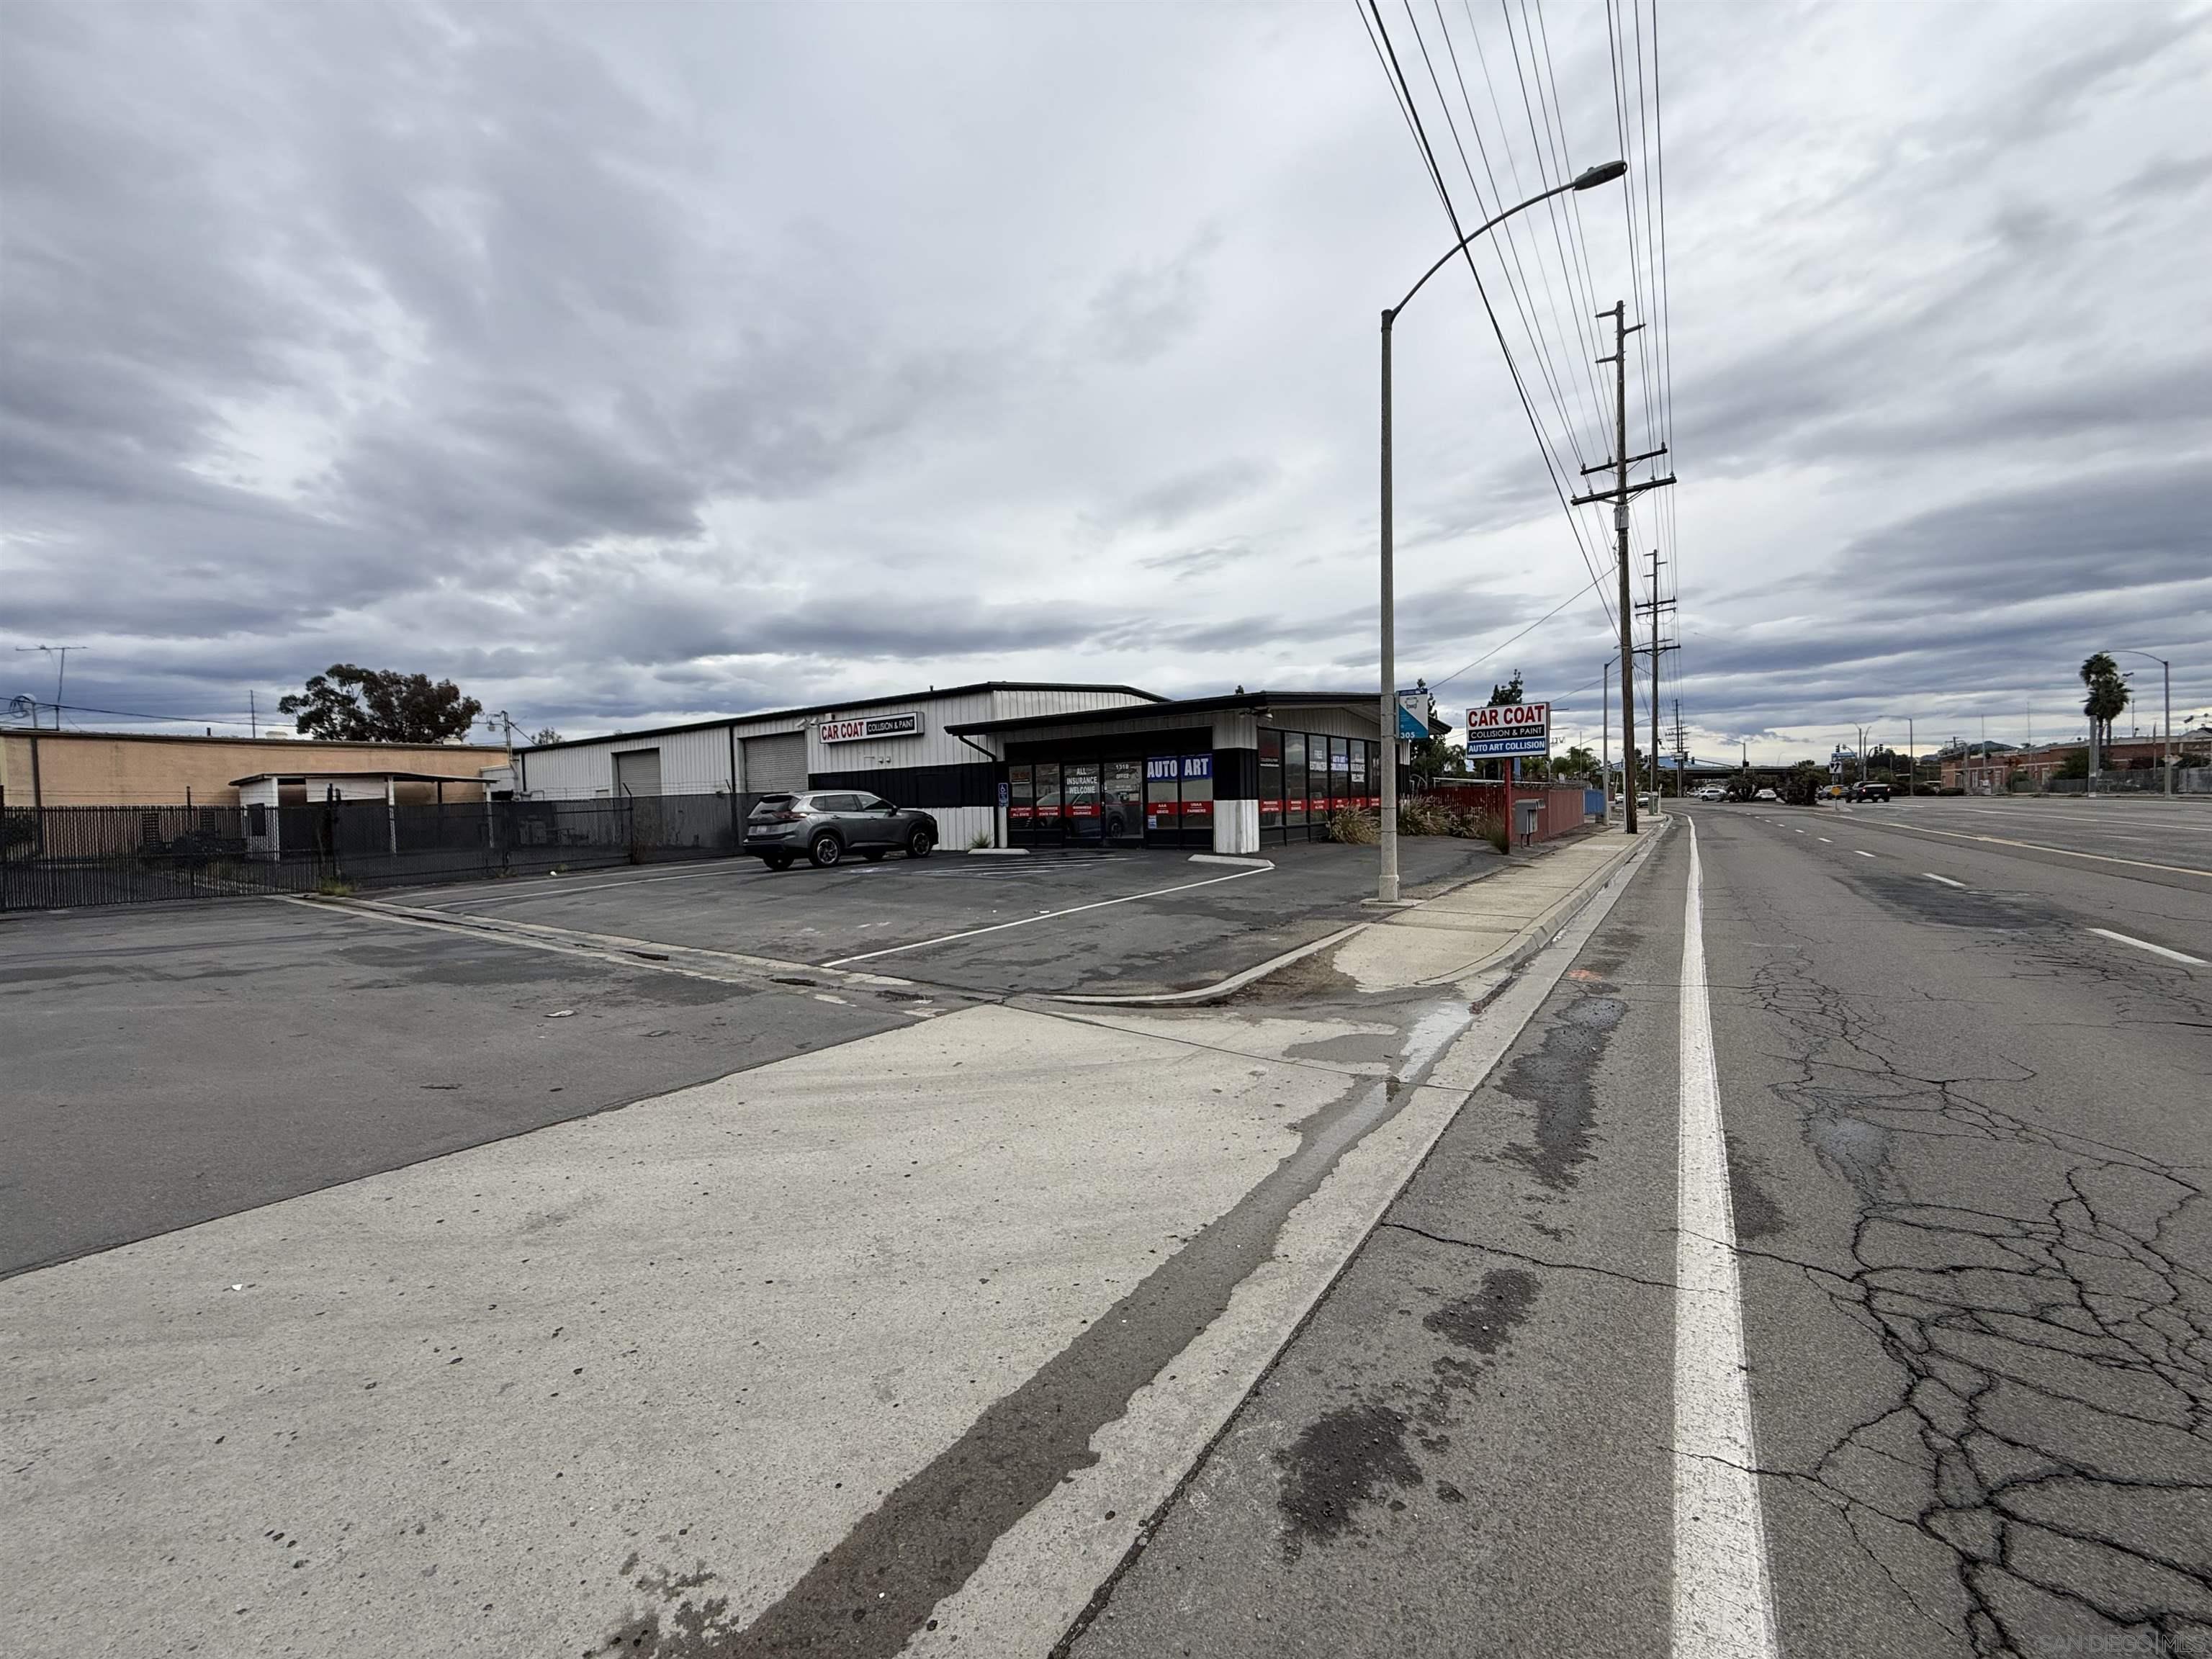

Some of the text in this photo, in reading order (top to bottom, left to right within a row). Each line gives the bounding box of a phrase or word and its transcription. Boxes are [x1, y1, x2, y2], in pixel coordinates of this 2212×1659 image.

[1469, 705, 1545, 727] CAR COAT
[822, 721, 864, 740] CAR COAT
[868, 721, 893, 732] COLLISION
[899, 719, 914, 728] PAINT
[1471, 729, 1510, 739] COLLISION
[1506, 741, 1545, 750] COLLISION
[1076, 767, 1087, 775] ALL
[1147, 757, 1209, 778] AUTO ART
[1066, 776, 1097, 785] INSURANCE
[1069, 786, 1095, 794] WELCOME
